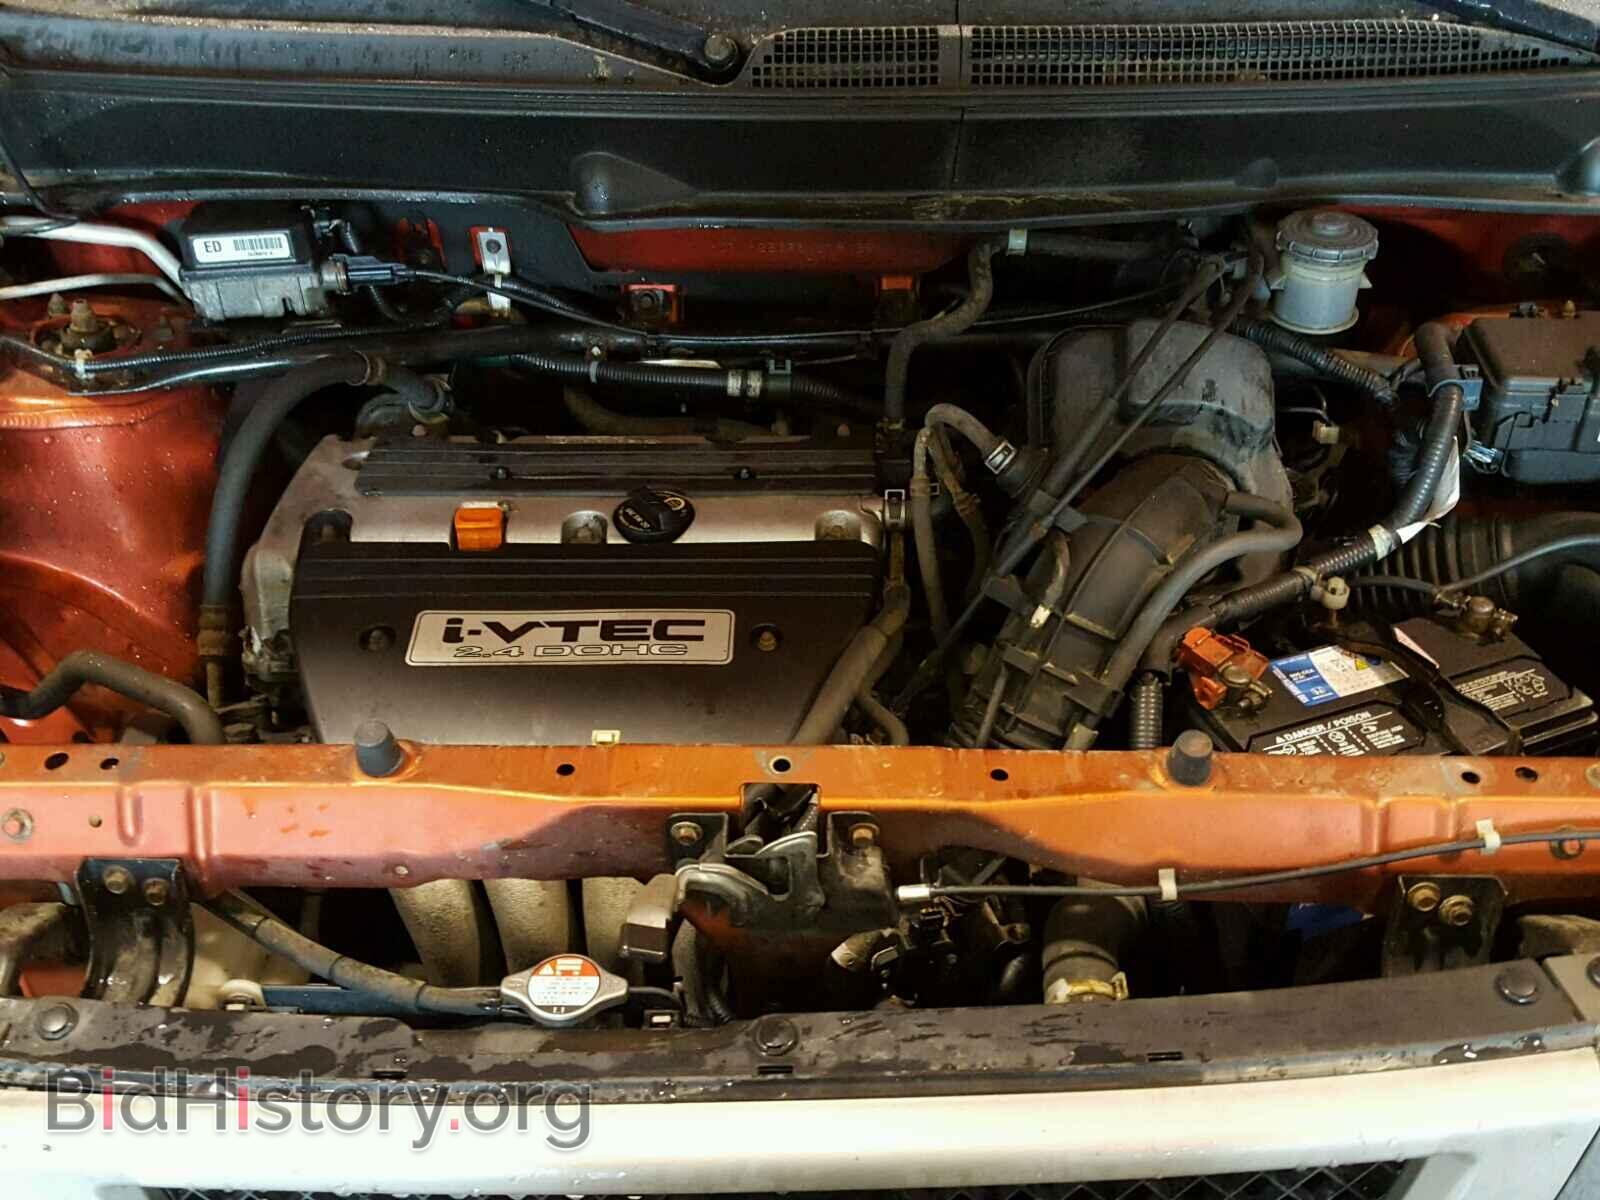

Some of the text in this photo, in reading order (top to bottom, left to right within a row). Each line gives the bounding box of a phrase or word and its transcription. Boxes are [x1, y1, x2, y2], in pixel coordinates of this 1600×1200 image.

[203, 240, 222, 253] ED
[442, 617, 705, 644] i-VTEC
[453, 643, 688, 658] 2.4 DOHC
[1283, 724, 1326, 740] DANGER
[1333, 711, 1372, 727] POISON
